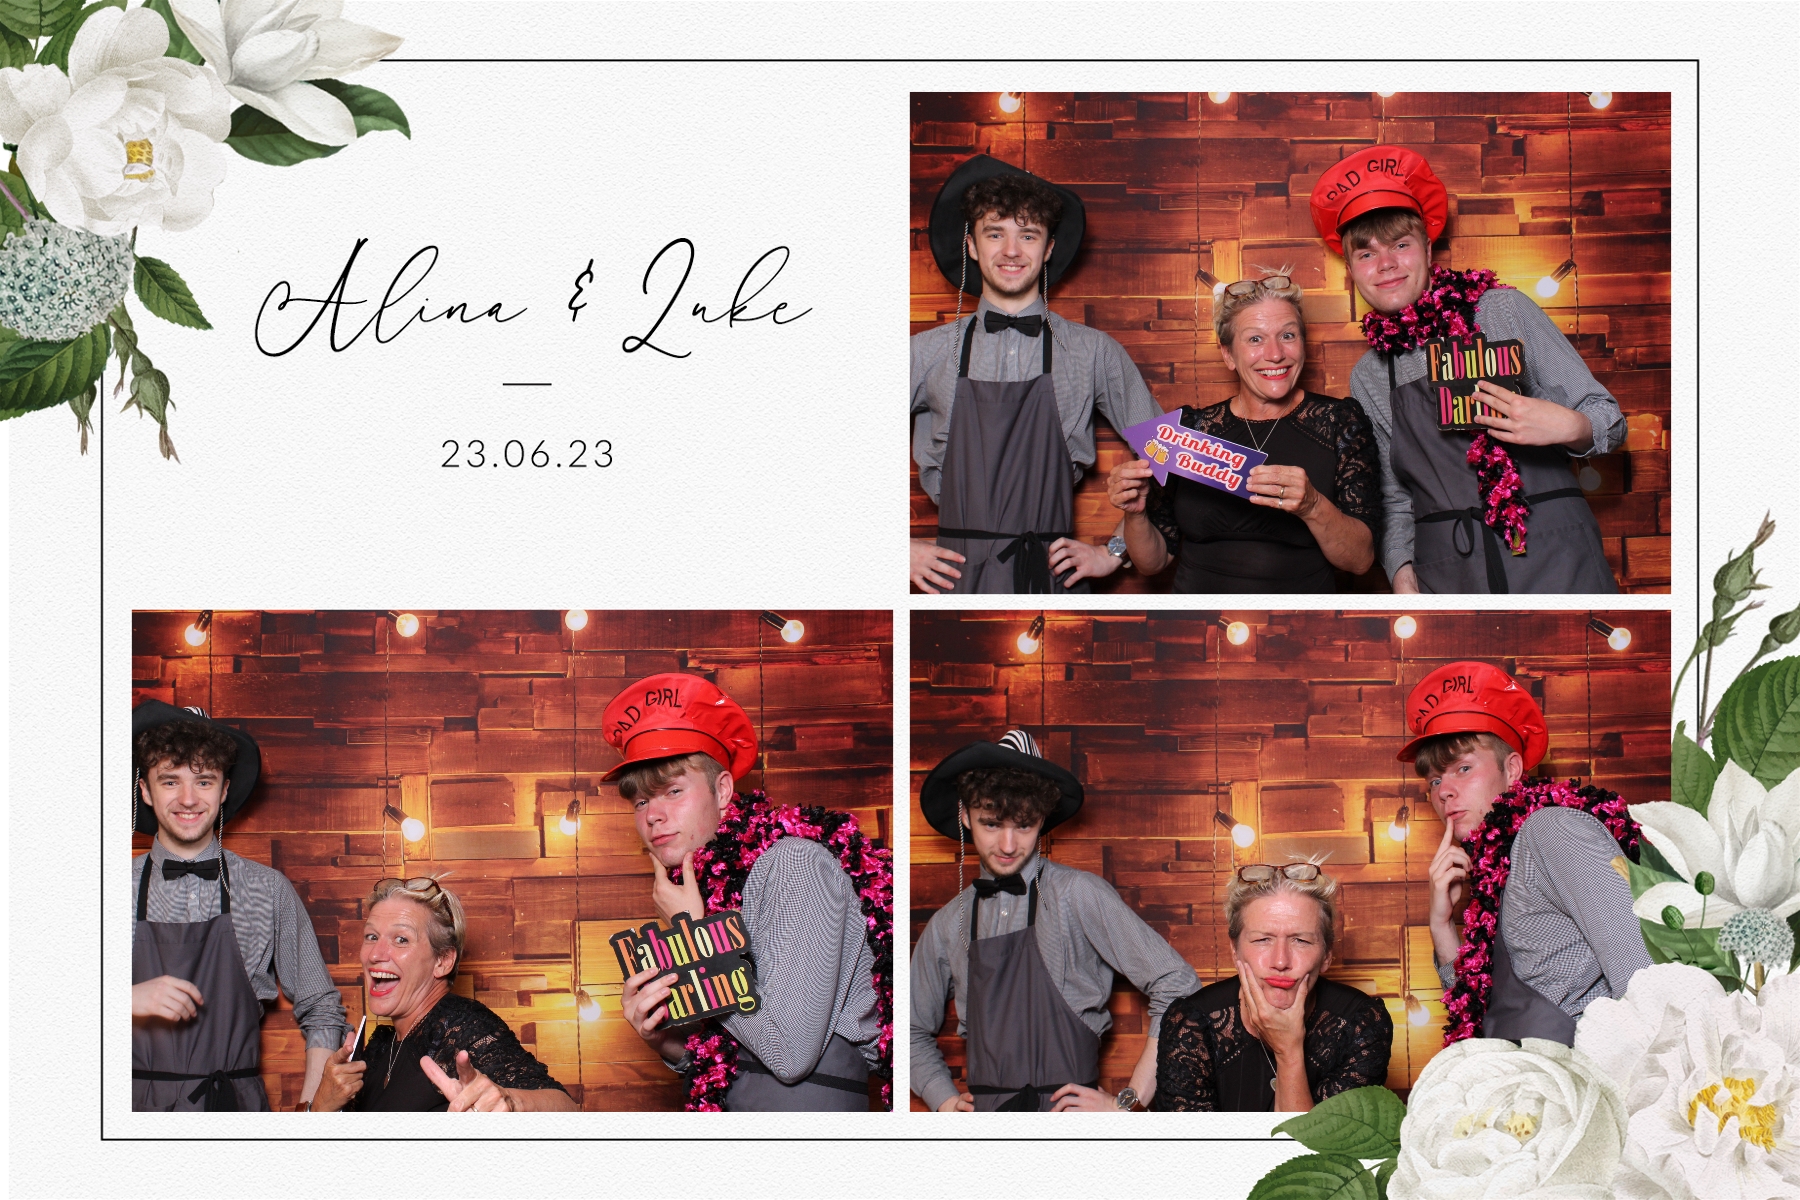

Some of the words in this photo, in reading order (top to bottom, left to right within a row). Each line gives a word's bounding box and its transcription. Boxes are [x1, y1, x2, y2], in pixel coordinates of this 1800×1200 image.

[1366, 158, 1404, 177] GIRL
[1428, 338, 1522, 382] Fabulous
[1439, 384, 1516, 425] Darl
[1157, 424, 1247, 470] Drinking
[1176, 452, 1242, 490] Buddy
[645, 688, 683, 708] GIRL
[1442, 675, 1475, 694] GIRL
[615, 915, 747, 977] Fabulous
[644, 966, 756, 1023] arling
